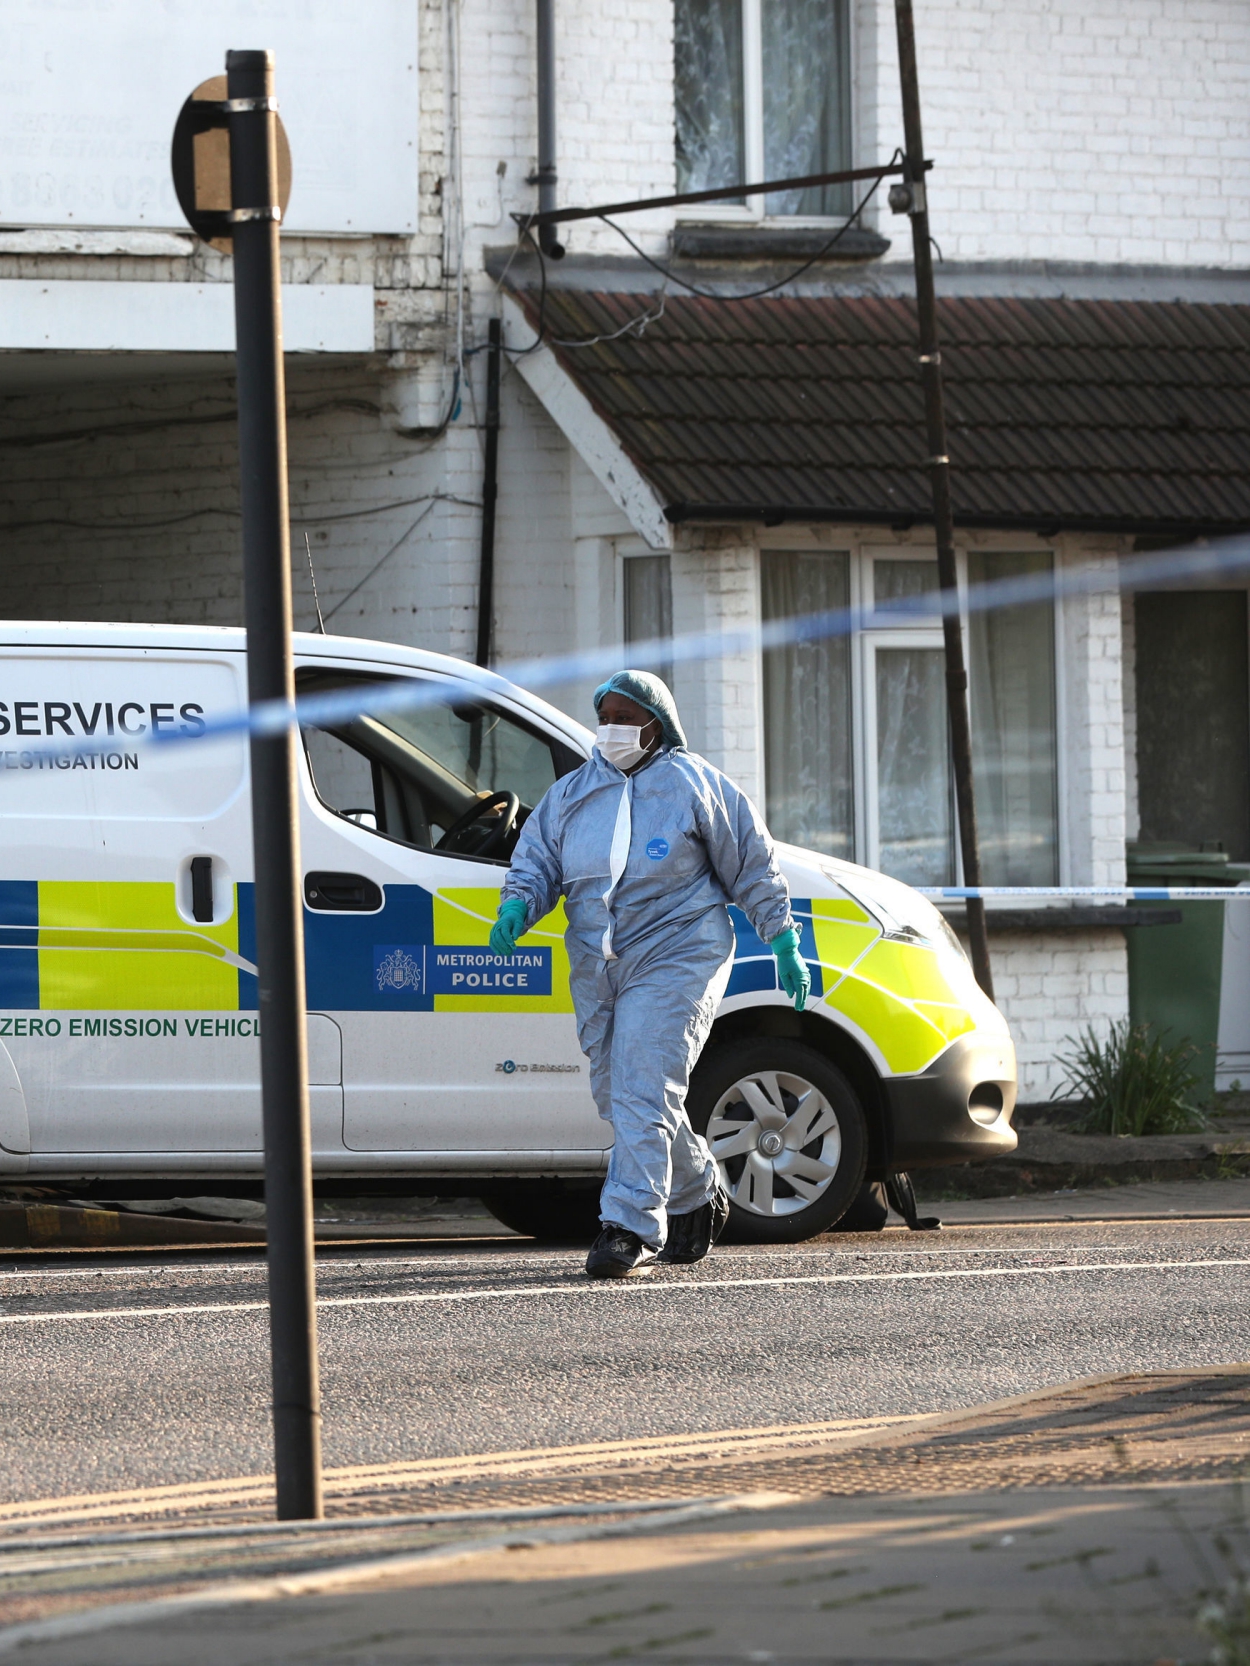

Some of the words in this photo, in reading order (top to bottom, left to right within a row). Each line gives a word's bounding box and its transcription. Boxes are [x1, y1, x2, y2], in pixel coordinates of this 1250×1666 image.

[436, 954, 543, 967] METROPOLITAN
[452, 972, 529, 988] POLICE
[0, 1018, 62, 1037] ZERO
[68, 1018, 178, 1037] EMISSION
